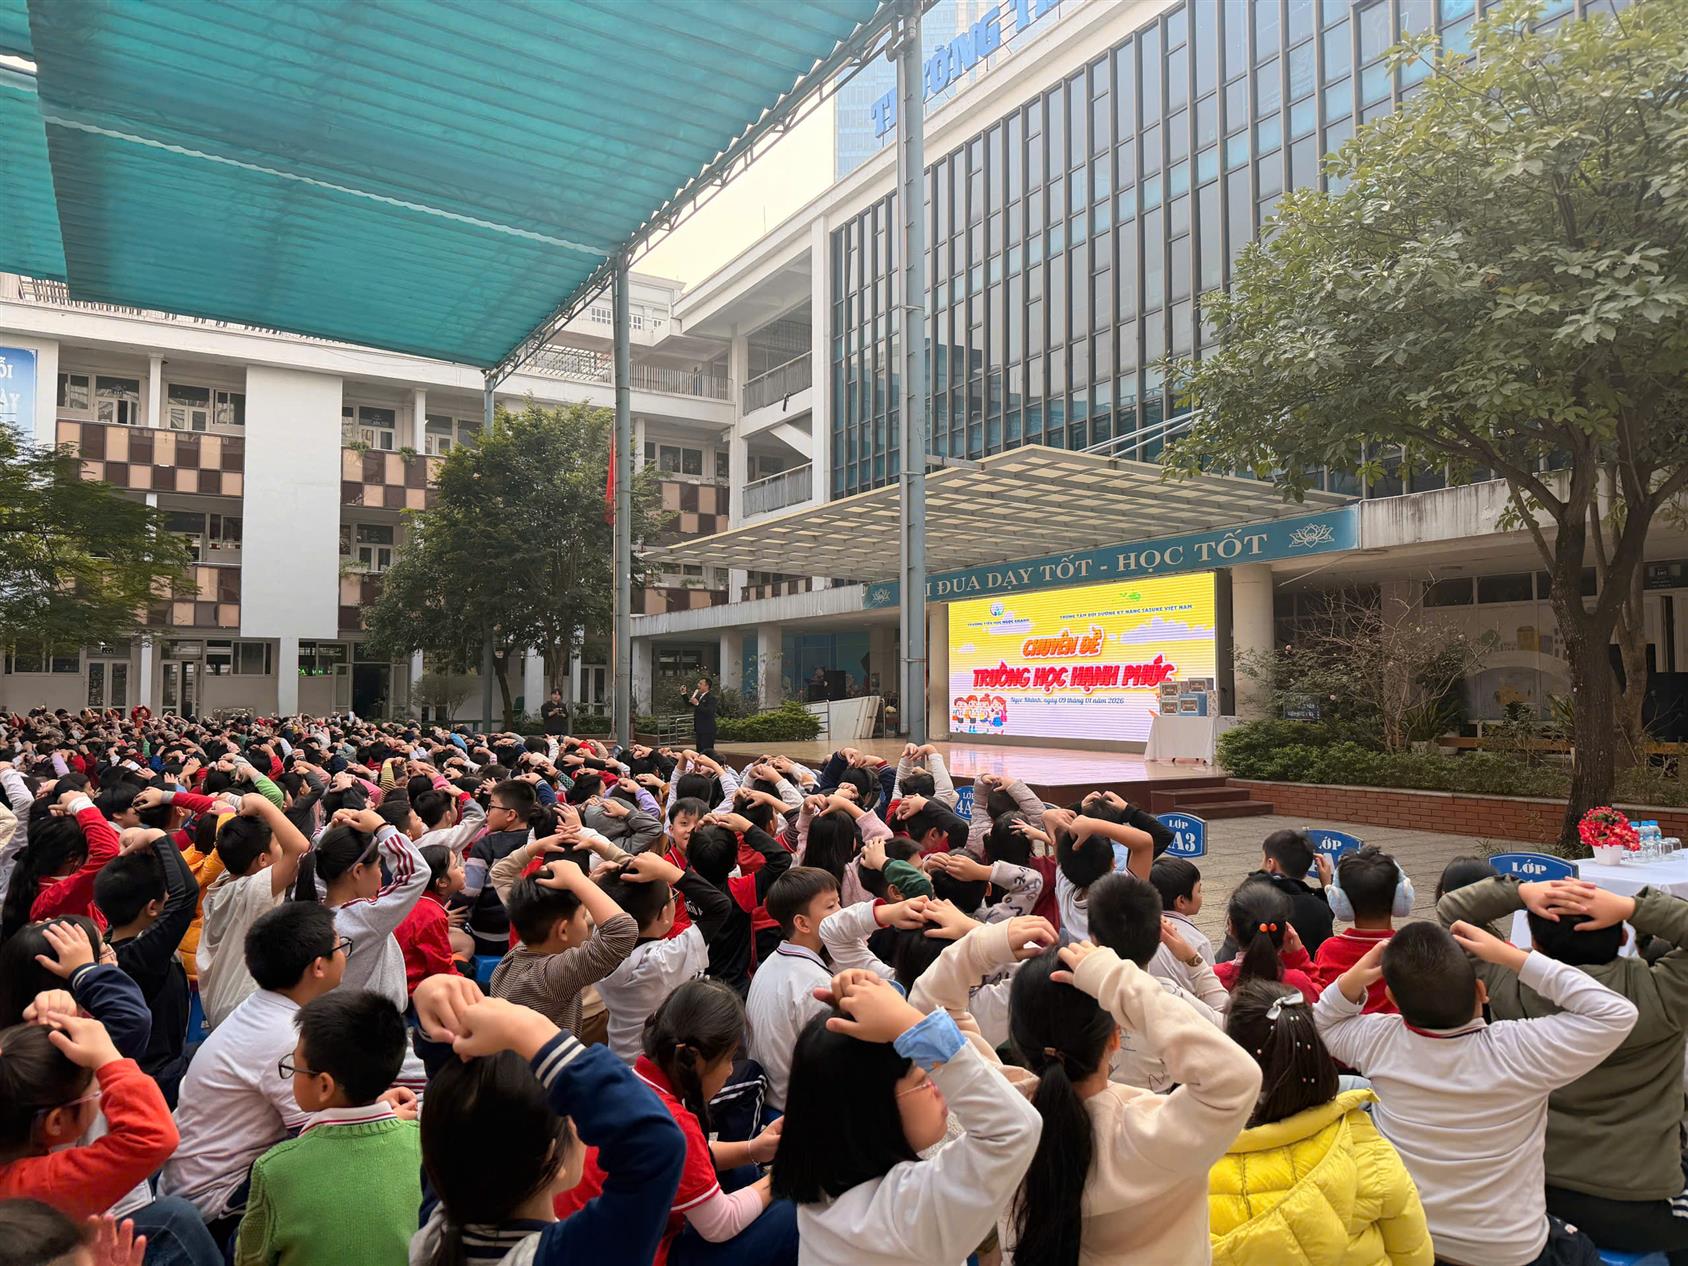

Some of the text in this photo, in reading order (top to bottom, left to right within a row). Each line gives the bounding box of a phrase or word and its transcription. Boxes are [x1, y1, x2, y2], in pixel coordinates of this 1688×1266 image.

[937, 575, 981, 596] ĐUA
[987, 567, 1033, 589] DẠY
[1040, 554, 1092, 581] TỐT
[1116, 546, 1184, 572] HỌC
[1194, 529, 1268, 562] TỐT
[1023, 627, 1102, 656] CHUYÊN ĐỀ
[973, 654, 1175, 692] TRƯỜNG HỌC HẠNH PHÚC
[1168, 831, 1196, 852] A3
[1318, 836, 1342, 850] ỚP
[1512, 859, 1547, 875] LỚP
